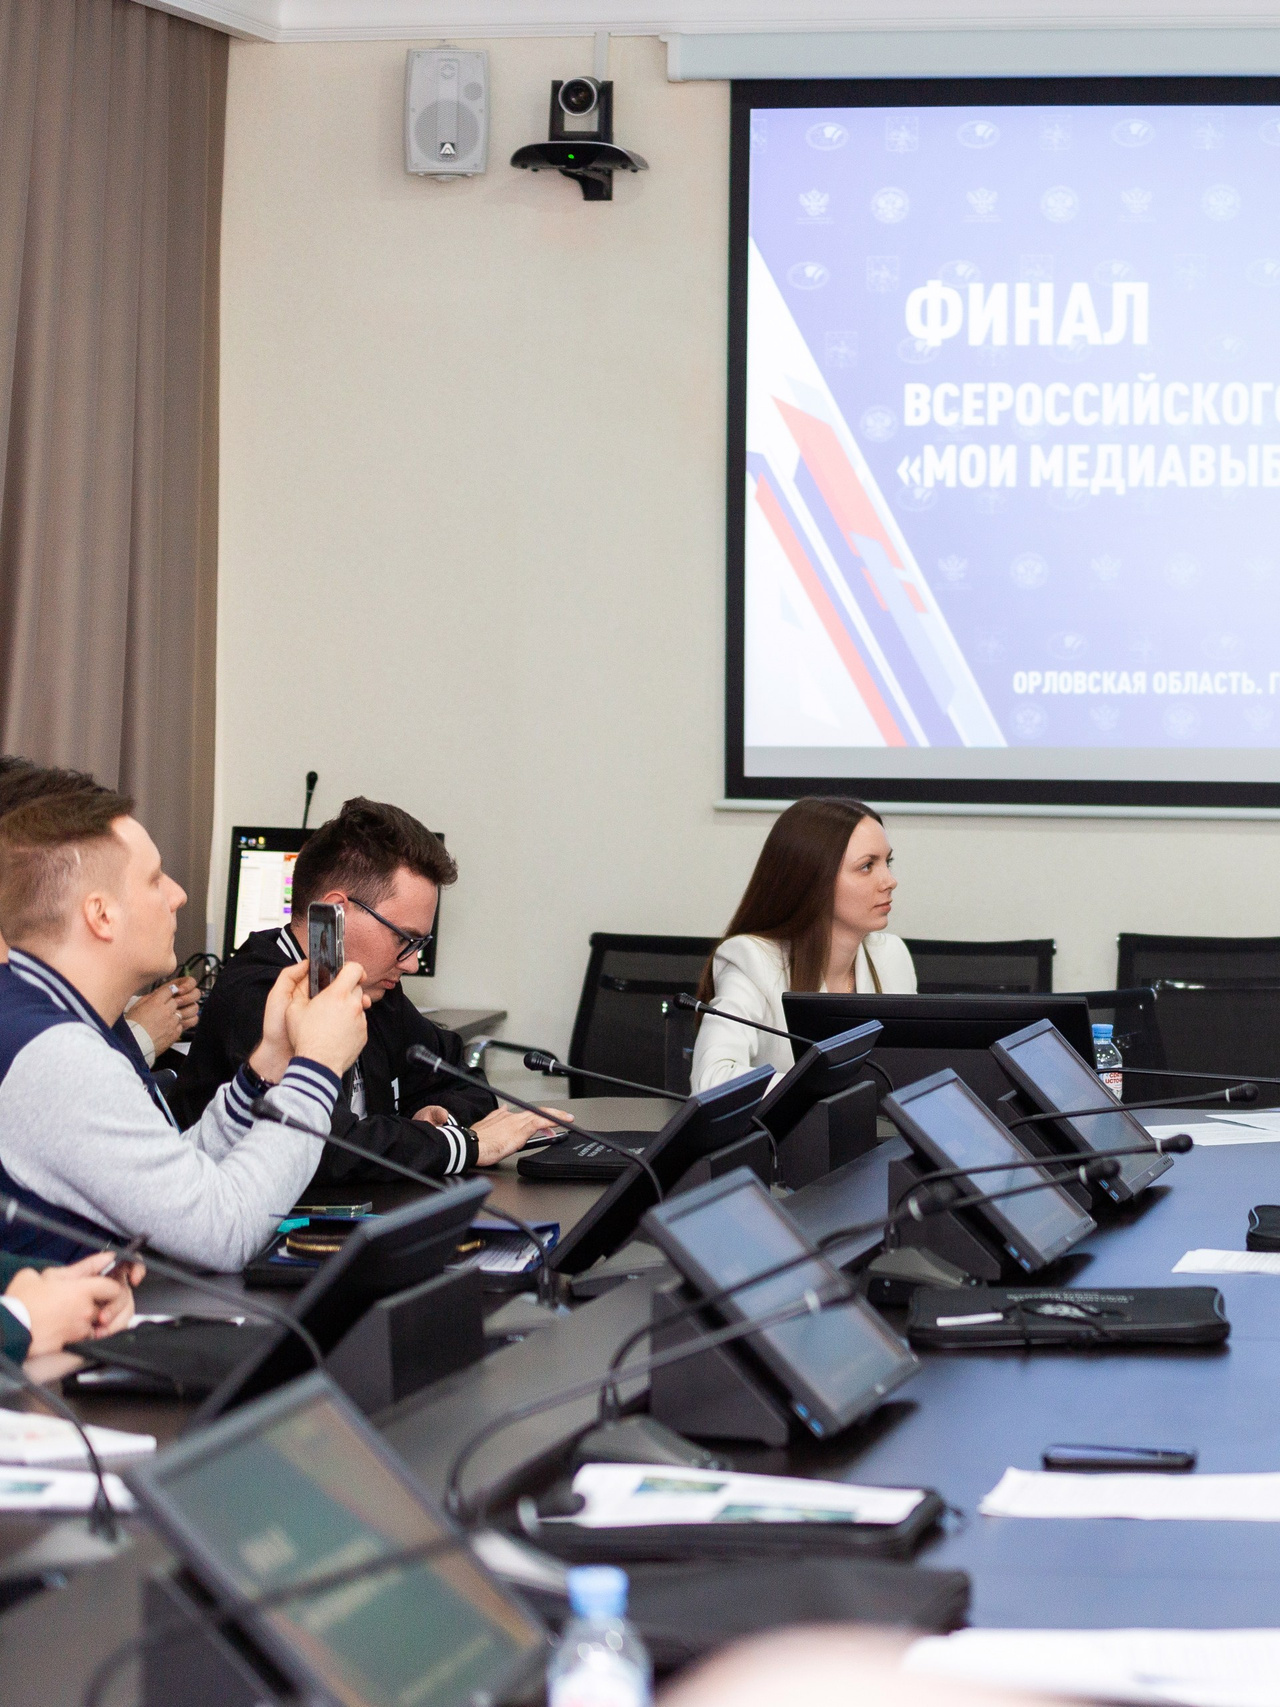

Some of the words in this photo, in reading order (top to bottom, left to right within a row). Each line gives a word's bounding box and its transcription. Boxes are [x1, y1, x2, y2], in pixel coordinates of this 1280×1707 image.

[905, 279, 1149, 347] ФИНАЛ
[898, 444, 1017, 488] «МОИ
[1012, 671, 1147, 695] ОРЛОВСКАЯ
